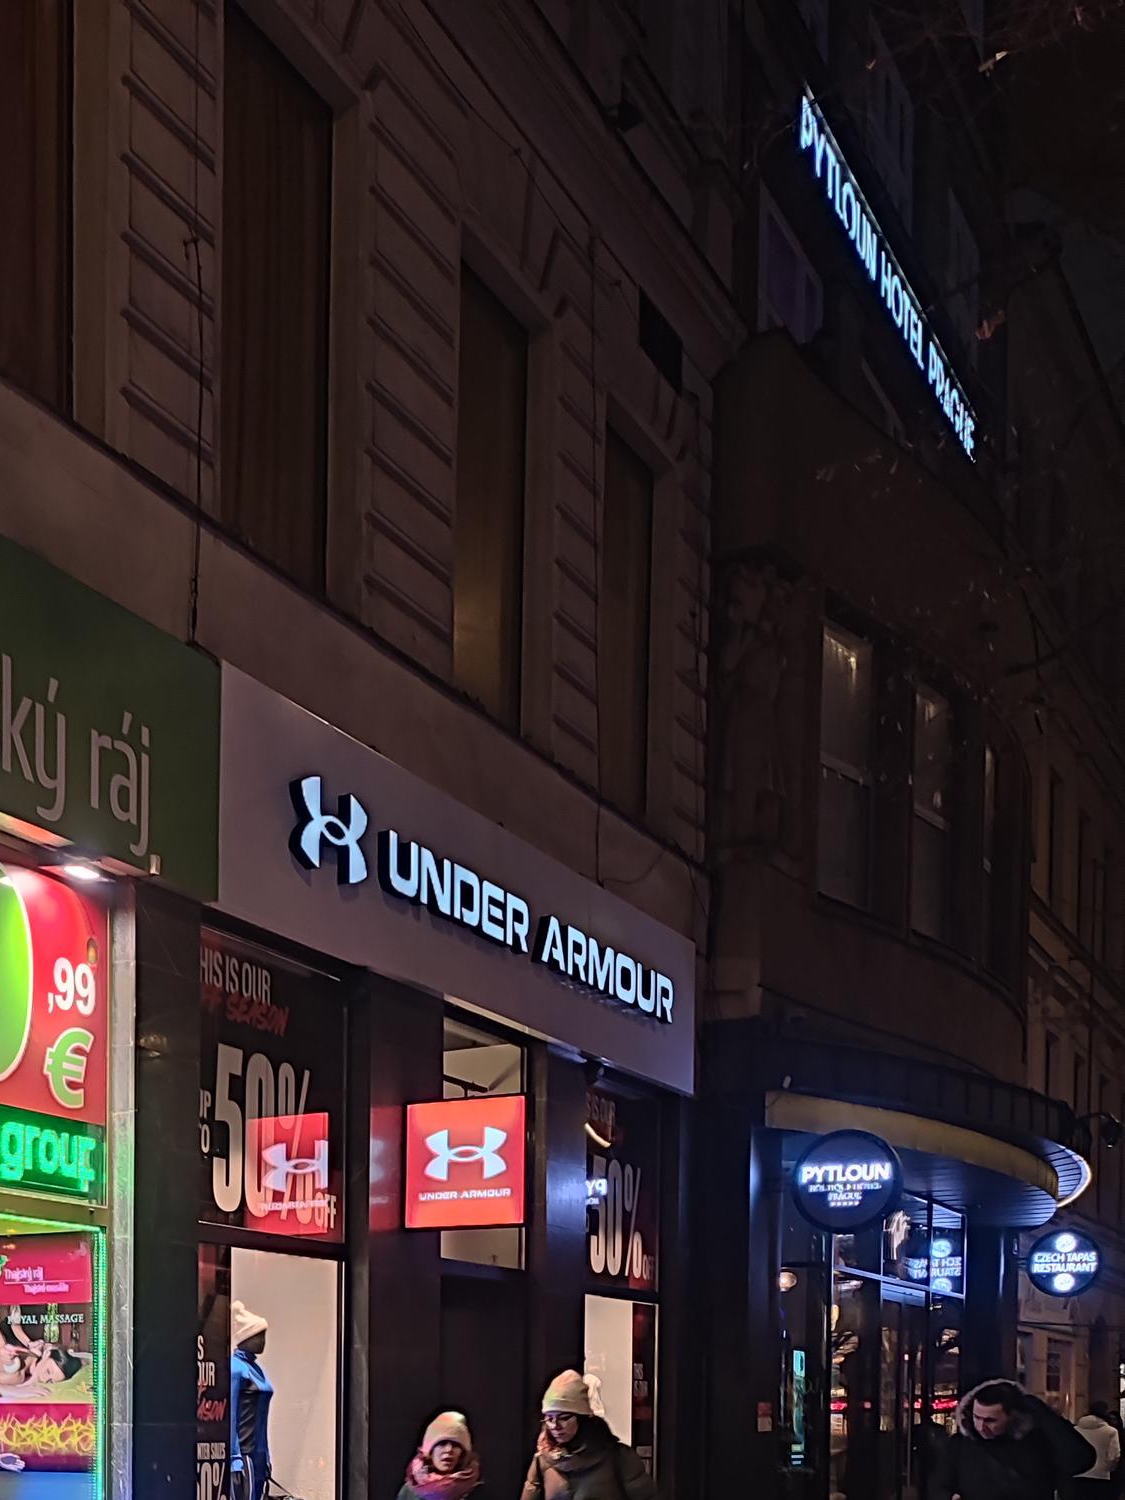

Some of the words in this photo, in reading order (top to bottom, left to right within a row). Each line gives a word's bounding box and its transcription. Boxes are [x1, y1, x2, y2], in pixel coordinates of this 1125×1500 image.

[800, 95, 877, 281] PYTLOUN
[880, 251, 925, 370] HOTEL
[90, 711, 151, 857] ráj
[385, 828, 530, 953] UNDER
[541, 915, 675, 1024] ARMOUR
[225, 955, 240, 994] IS
[242, 962, 271, 1007] OUR
[199, 1121, 211, 1154] O
[212, 1042, 313, 1225] 50%
[801, 1162, 893, 1185] PYTLOUN
[314, 1191, 337, 1229] OFF
[418, 1191, 458, 1201] UNDER
[460, 1187, 512, 1199] ARMOUR
[590, 1154, 643, 1280] 50%
[1032, 1262, 1098, 1273] RESTAURANT
[1034, 1252, 1065, 1263] CZECH
[1066, 1251, 1097, 1262] TAPAS
[40, 1313, 85, 1325] MASSAGE
